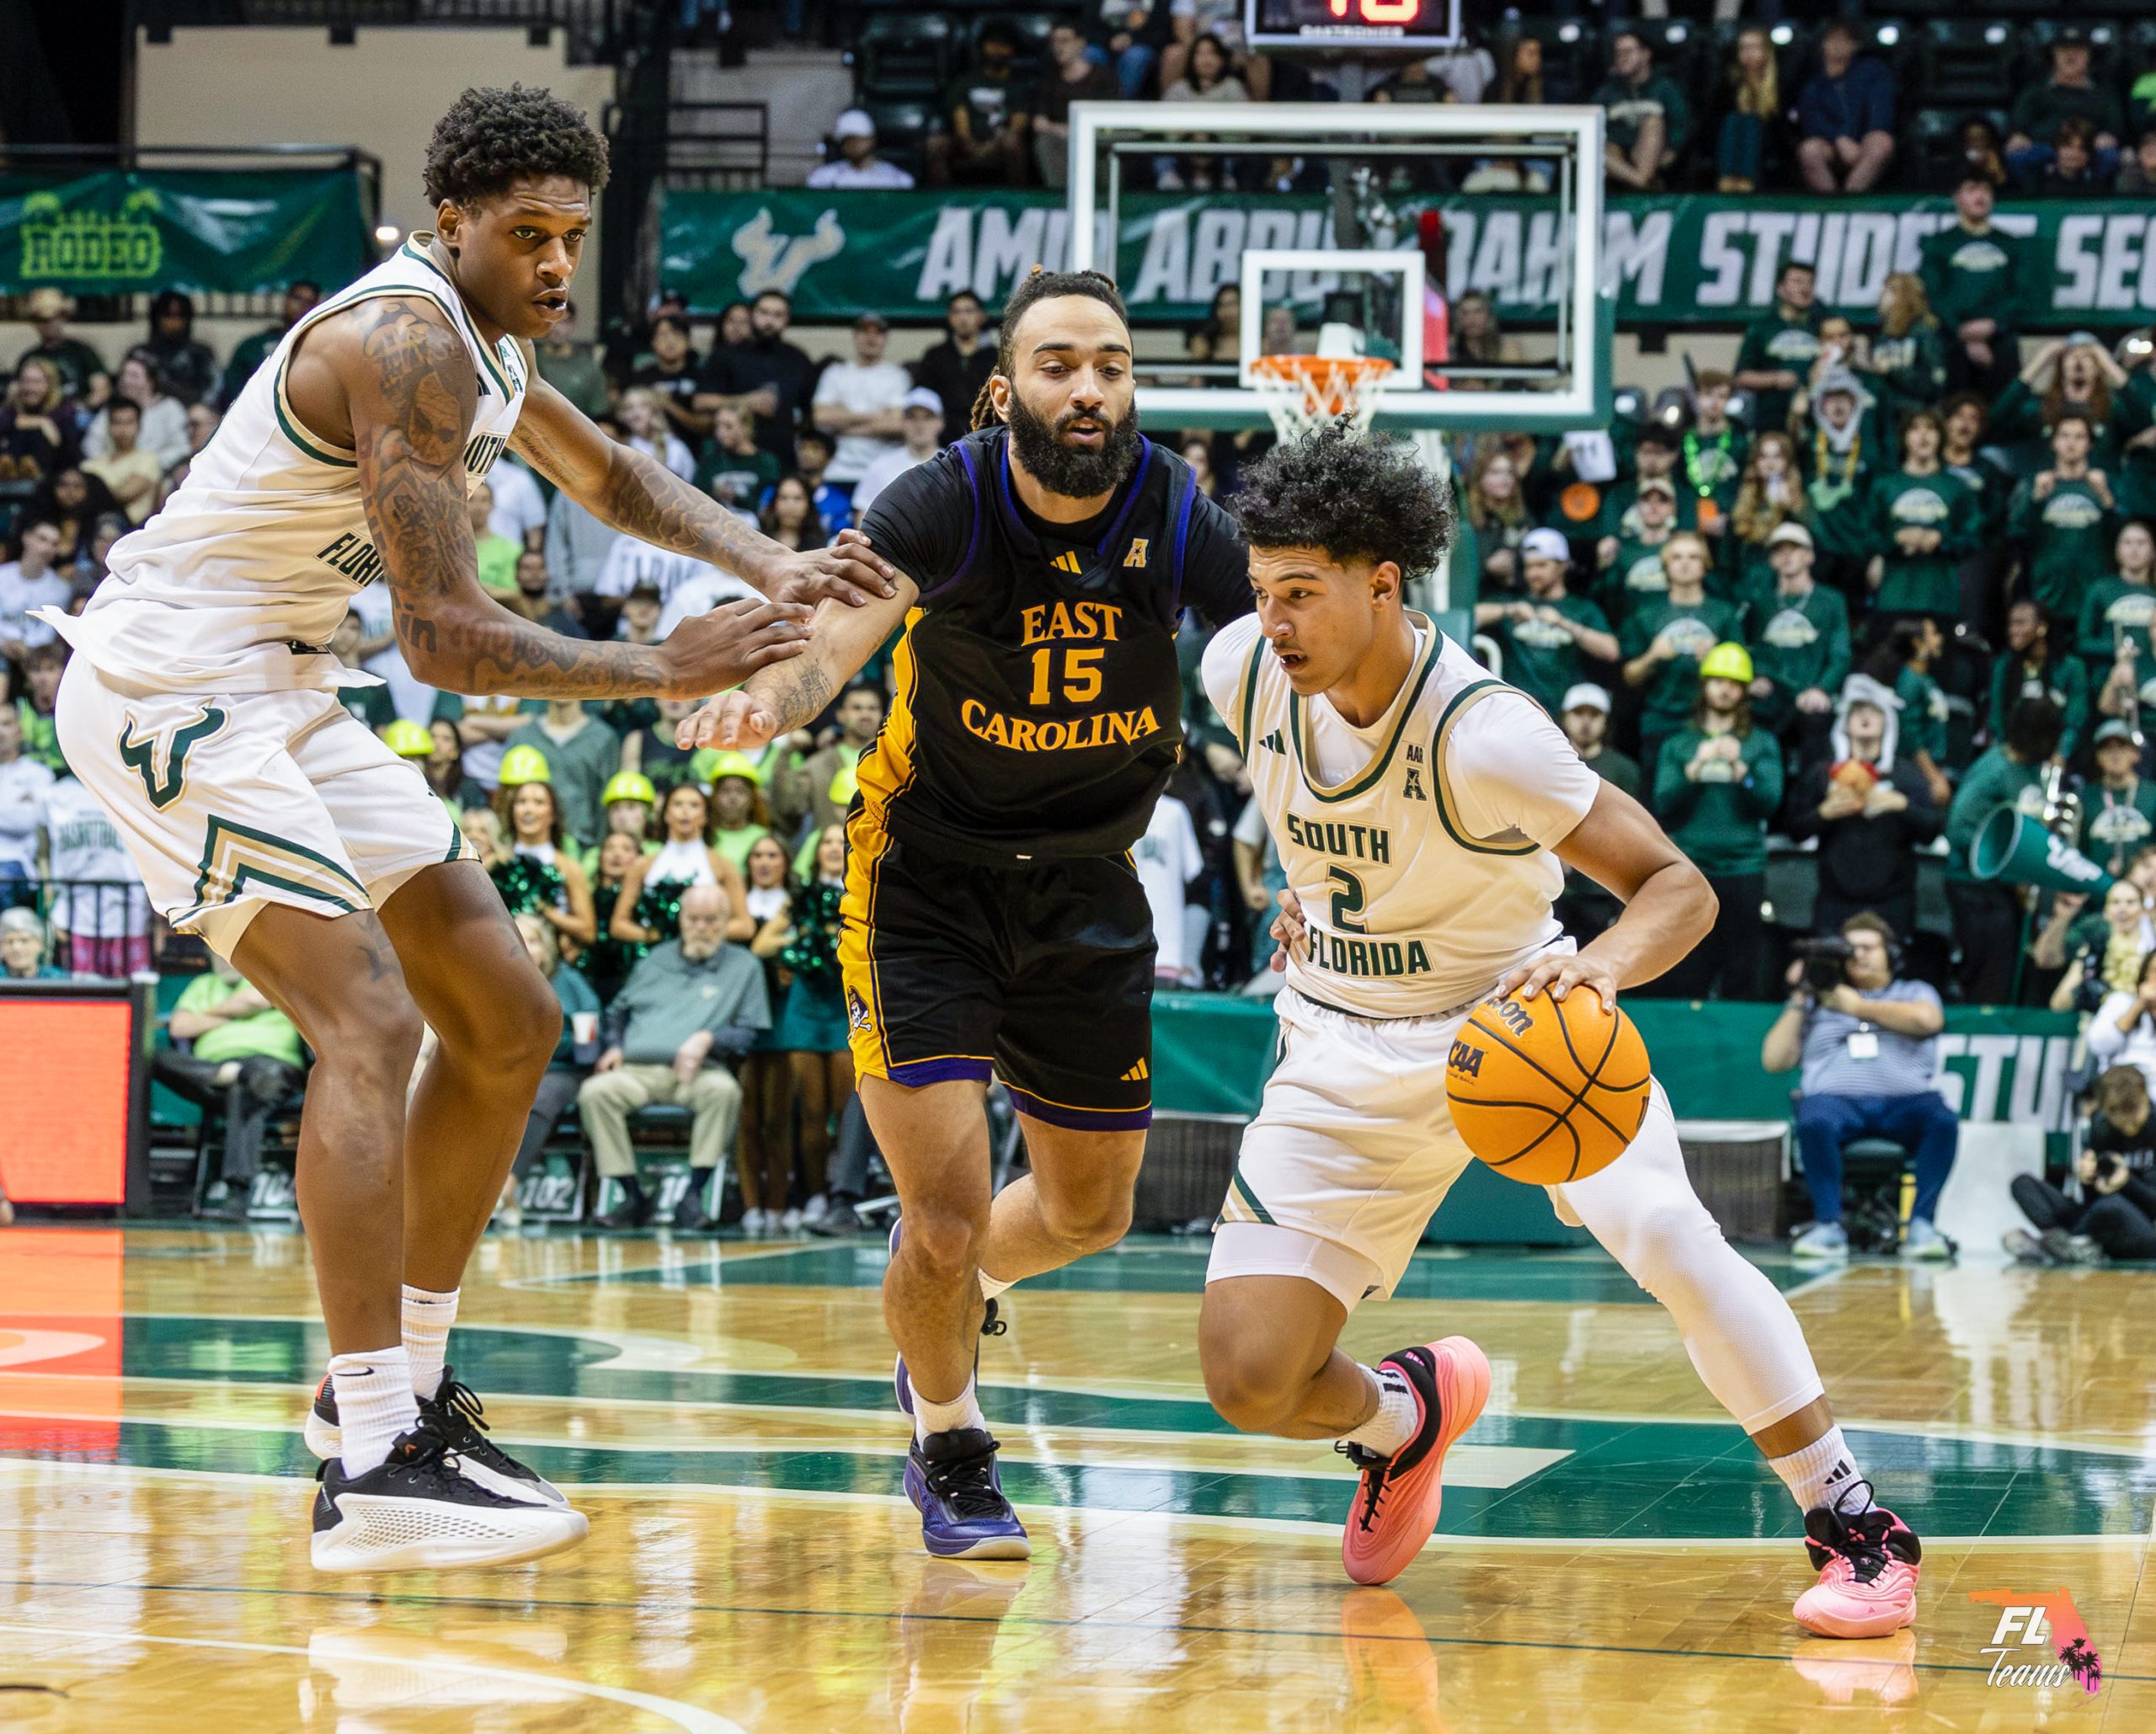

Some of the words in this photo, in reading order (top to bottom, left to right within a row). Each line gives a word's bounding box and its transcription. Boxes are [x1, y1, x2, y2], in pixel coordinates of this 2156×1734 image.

[1696, 212, 2038, 307] STUDE
[1021, 601, 1123, 647] EAST
[1029, 648, 1105, 705] 15
[961, 699, 1161, 752] CAROLINA
[1286, 813, 1390, 865] SOUTH
[1329, 865, 1369, 934] 2
[1307, 925, 1432, 978] FLORIDA
[1929, 1033, 2074, 1133] STU
